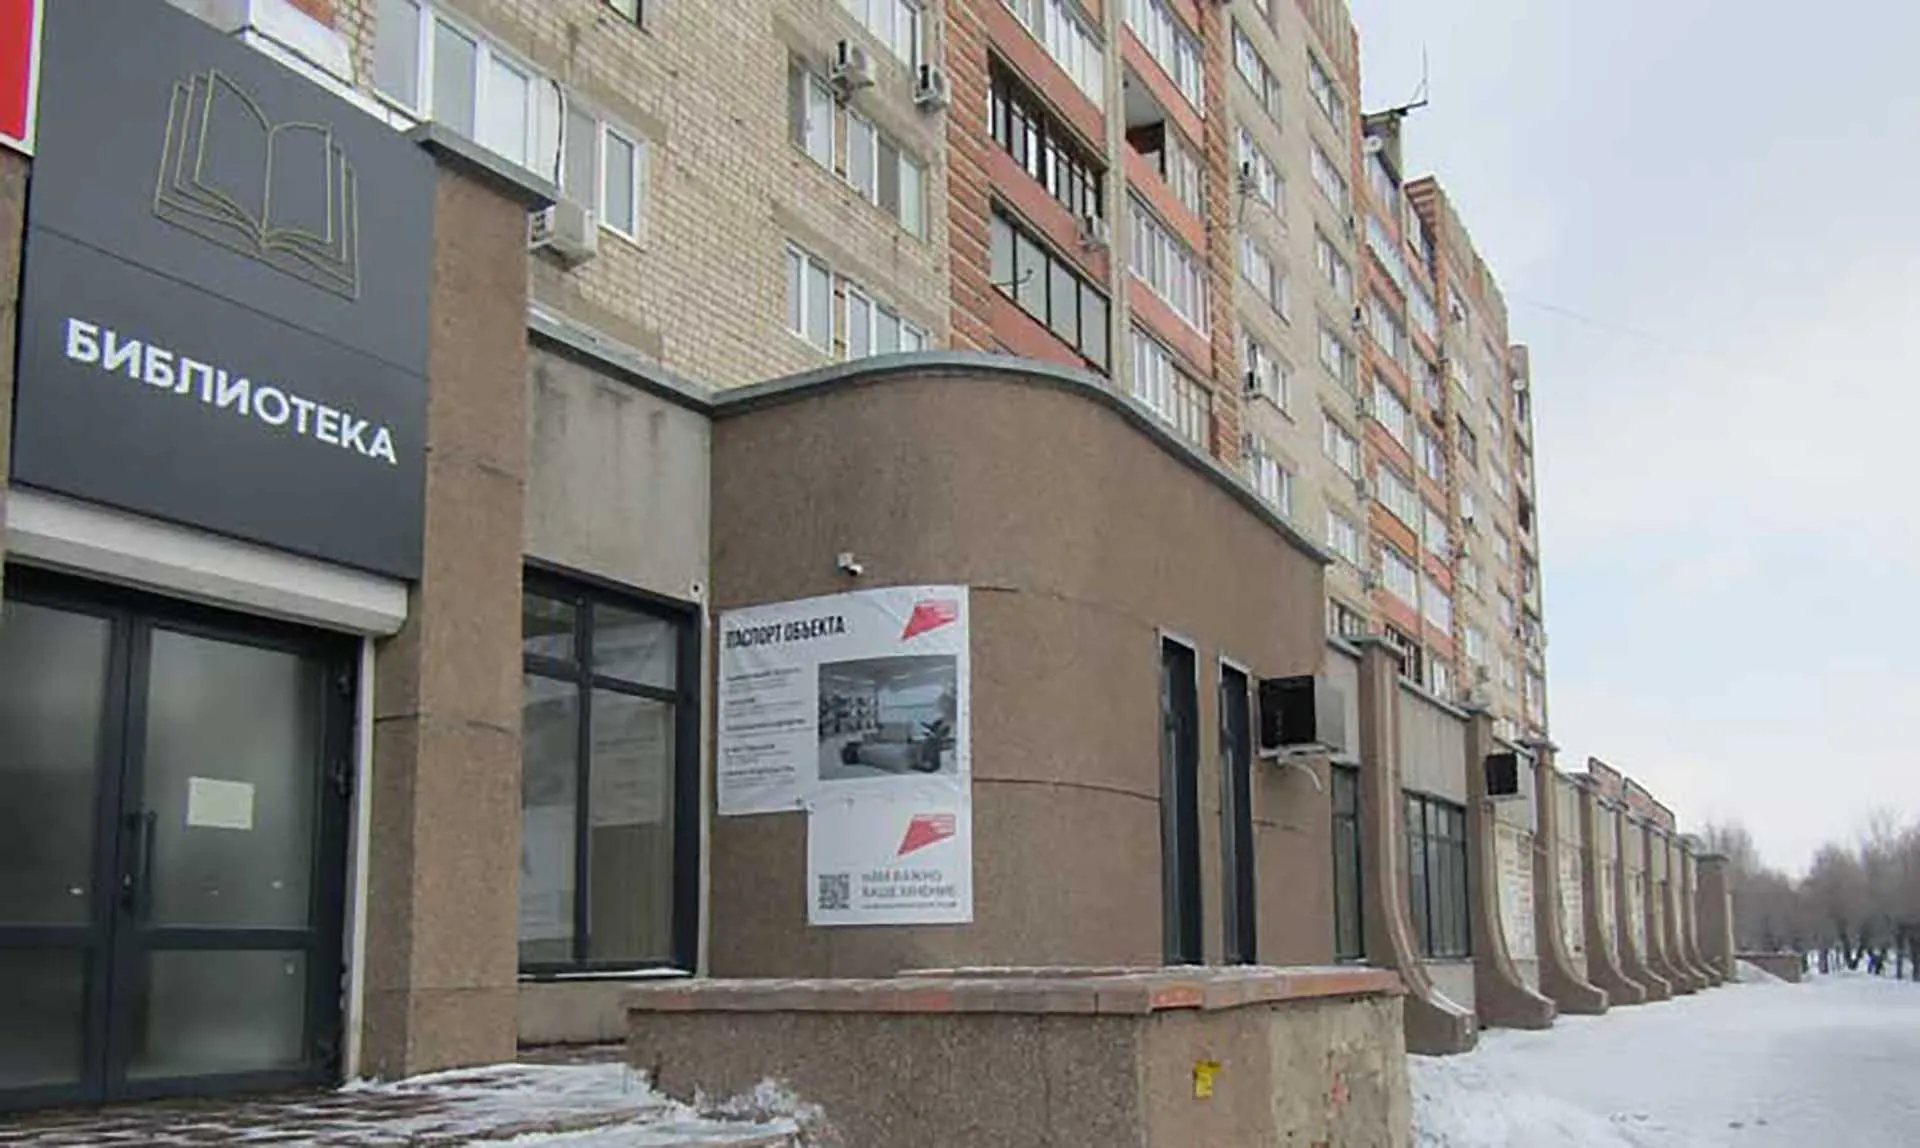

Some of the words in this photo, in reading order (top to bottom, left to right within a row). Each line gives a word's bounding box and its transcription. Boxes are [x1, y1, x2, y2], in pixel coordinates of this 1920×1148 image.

[66, 317, 398, 465] БИБЛИОТЕКА
[726, 624, 781, 648] ПАСПОРТ
[784, 615, 845, 641] ОБЪЕКТА
